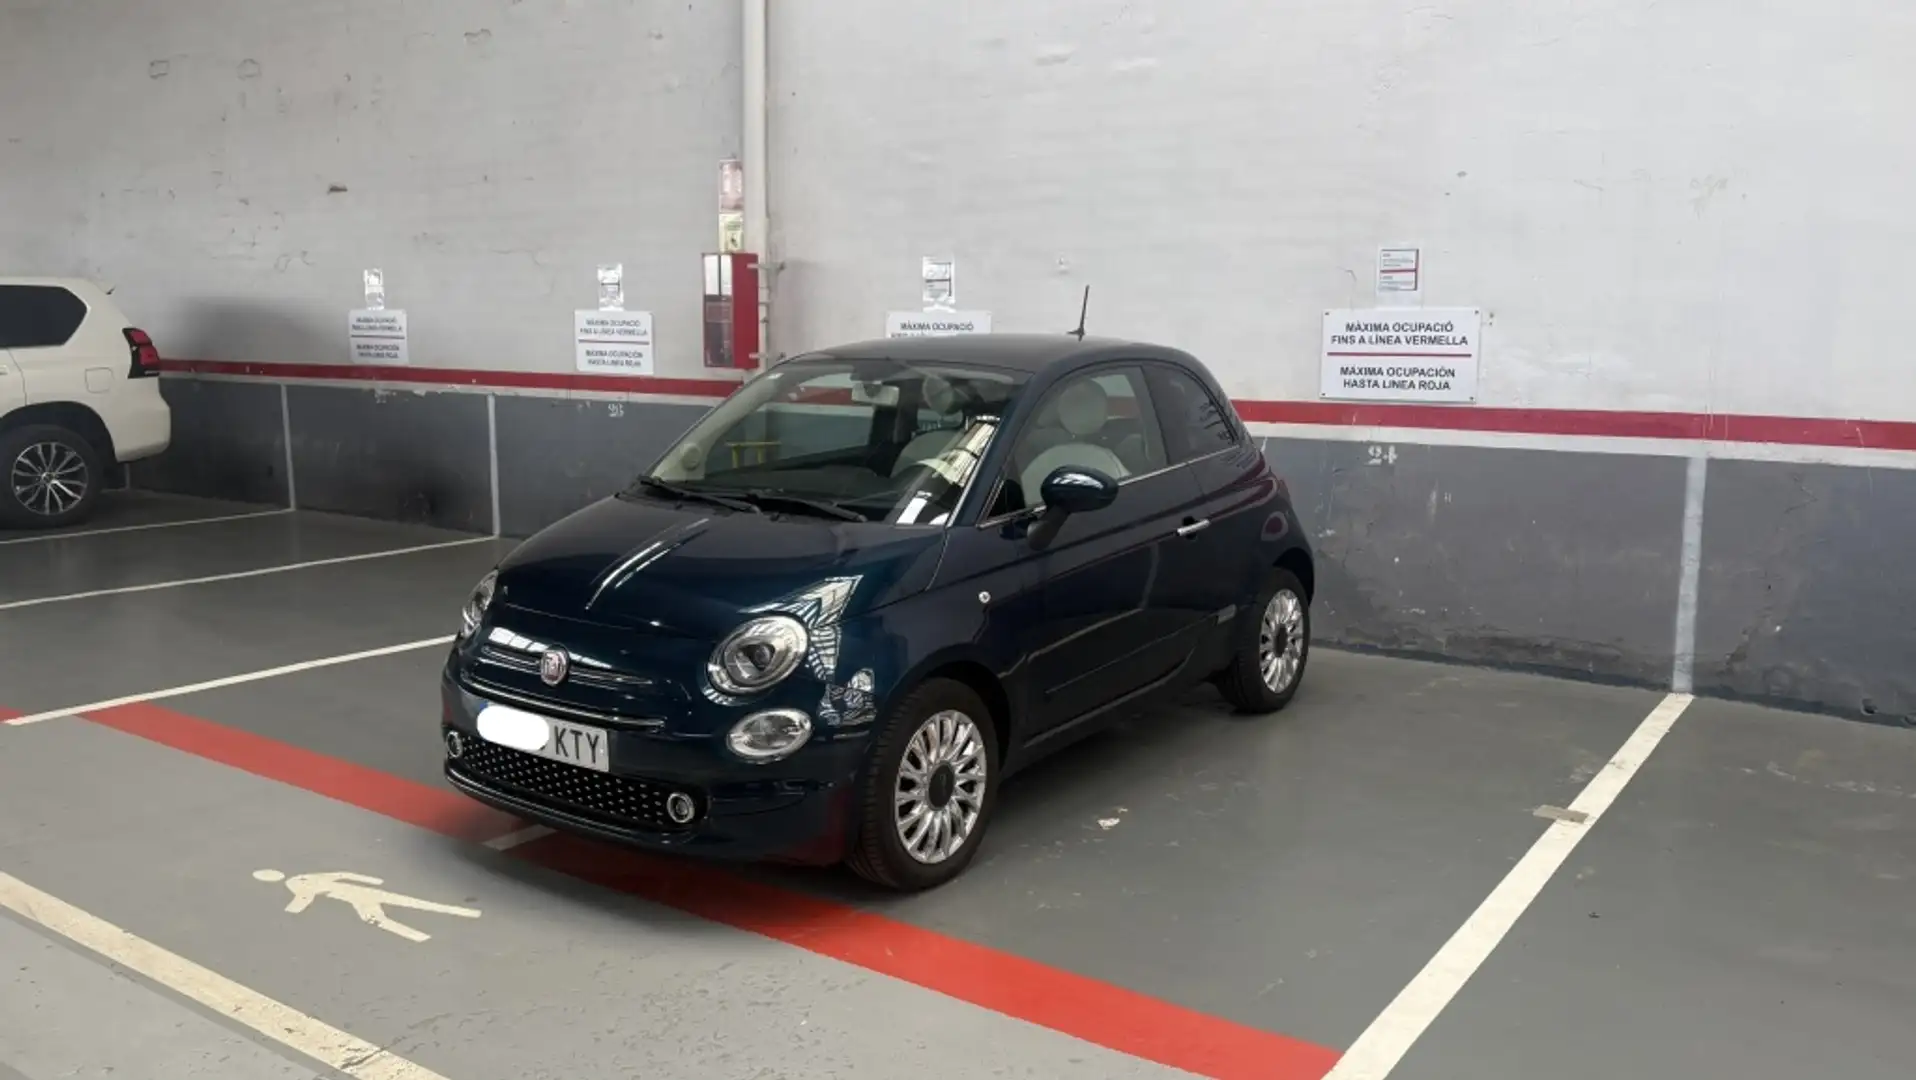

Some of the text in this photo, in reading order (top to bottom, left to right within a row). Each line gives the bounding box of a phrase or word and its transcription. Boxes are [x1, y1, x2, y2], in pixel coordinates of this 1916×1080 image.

[1392, 320, 1454, 333] OCUPACIÓ
[1331, 335, 1356, 345] FINS
[1358, 335, 1366, 345] A
[1405, 335, 1468, 346] VERMELLA
[1386, 365, 1455, 378] OCUPACIÓN
[1343, 379, 1380, 390] HASTA
[1418, 379, 1451, 391] ROJA
[553, 725, 600, 765] KTY
